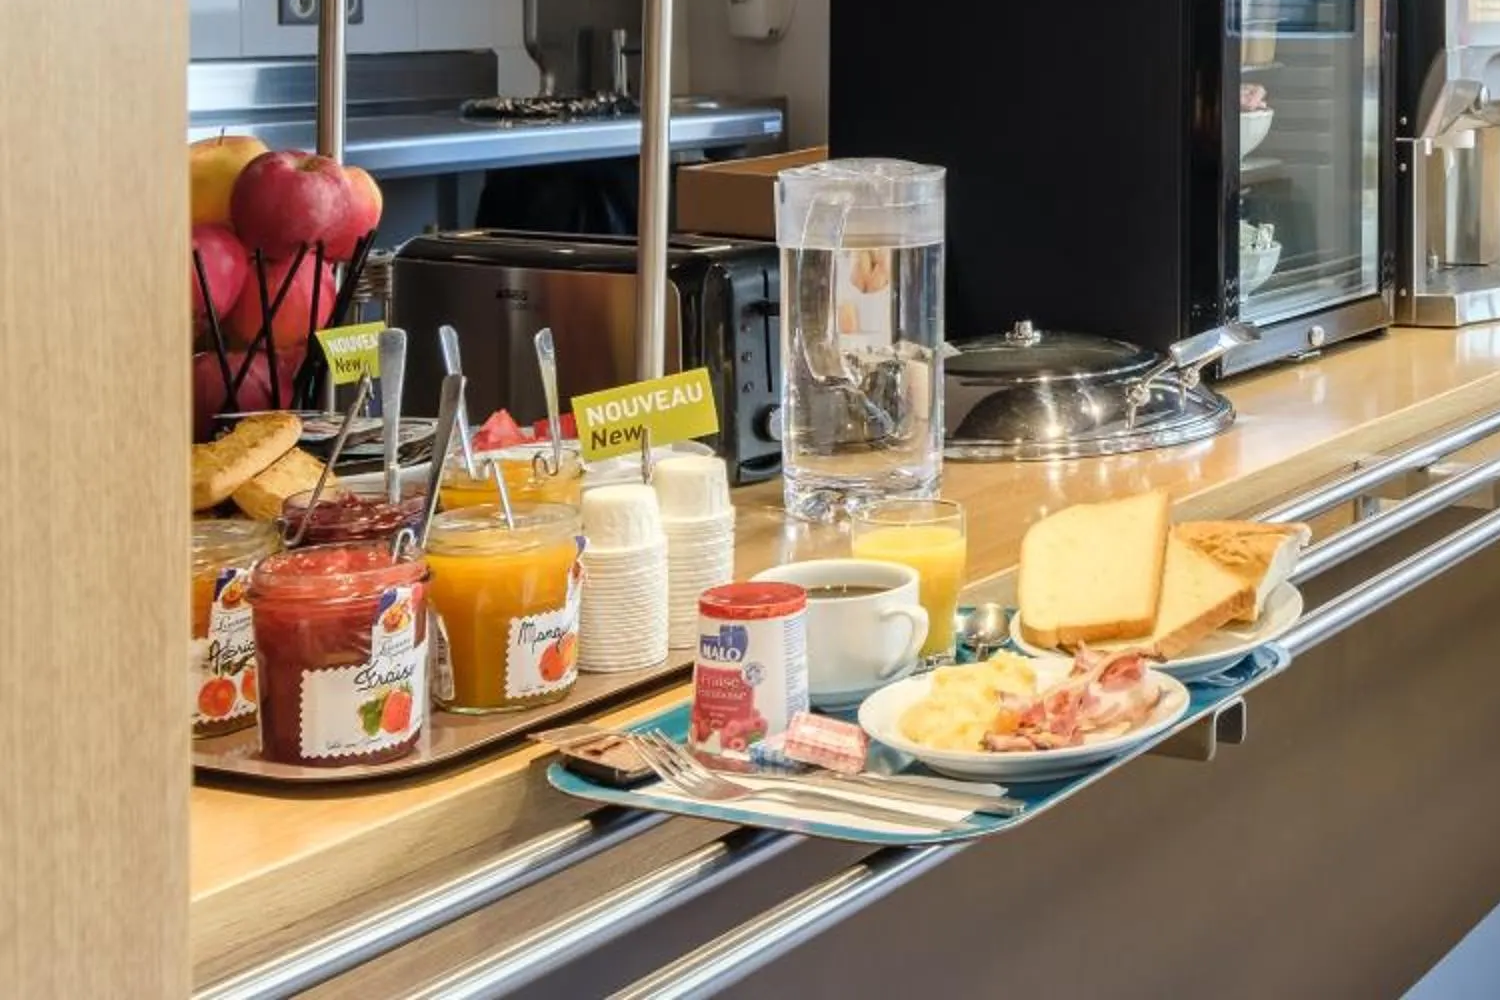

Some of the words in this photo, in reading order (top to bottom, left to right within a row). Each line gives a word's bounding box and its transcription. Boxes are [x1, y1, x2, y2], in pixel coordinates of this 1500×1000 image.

[328, 332, 379, 353] NOUVEA
[335, 358, 361, 373] New
[585, 382, 704, 427] NOUVEAU
[590, 424, 645, 450] New
